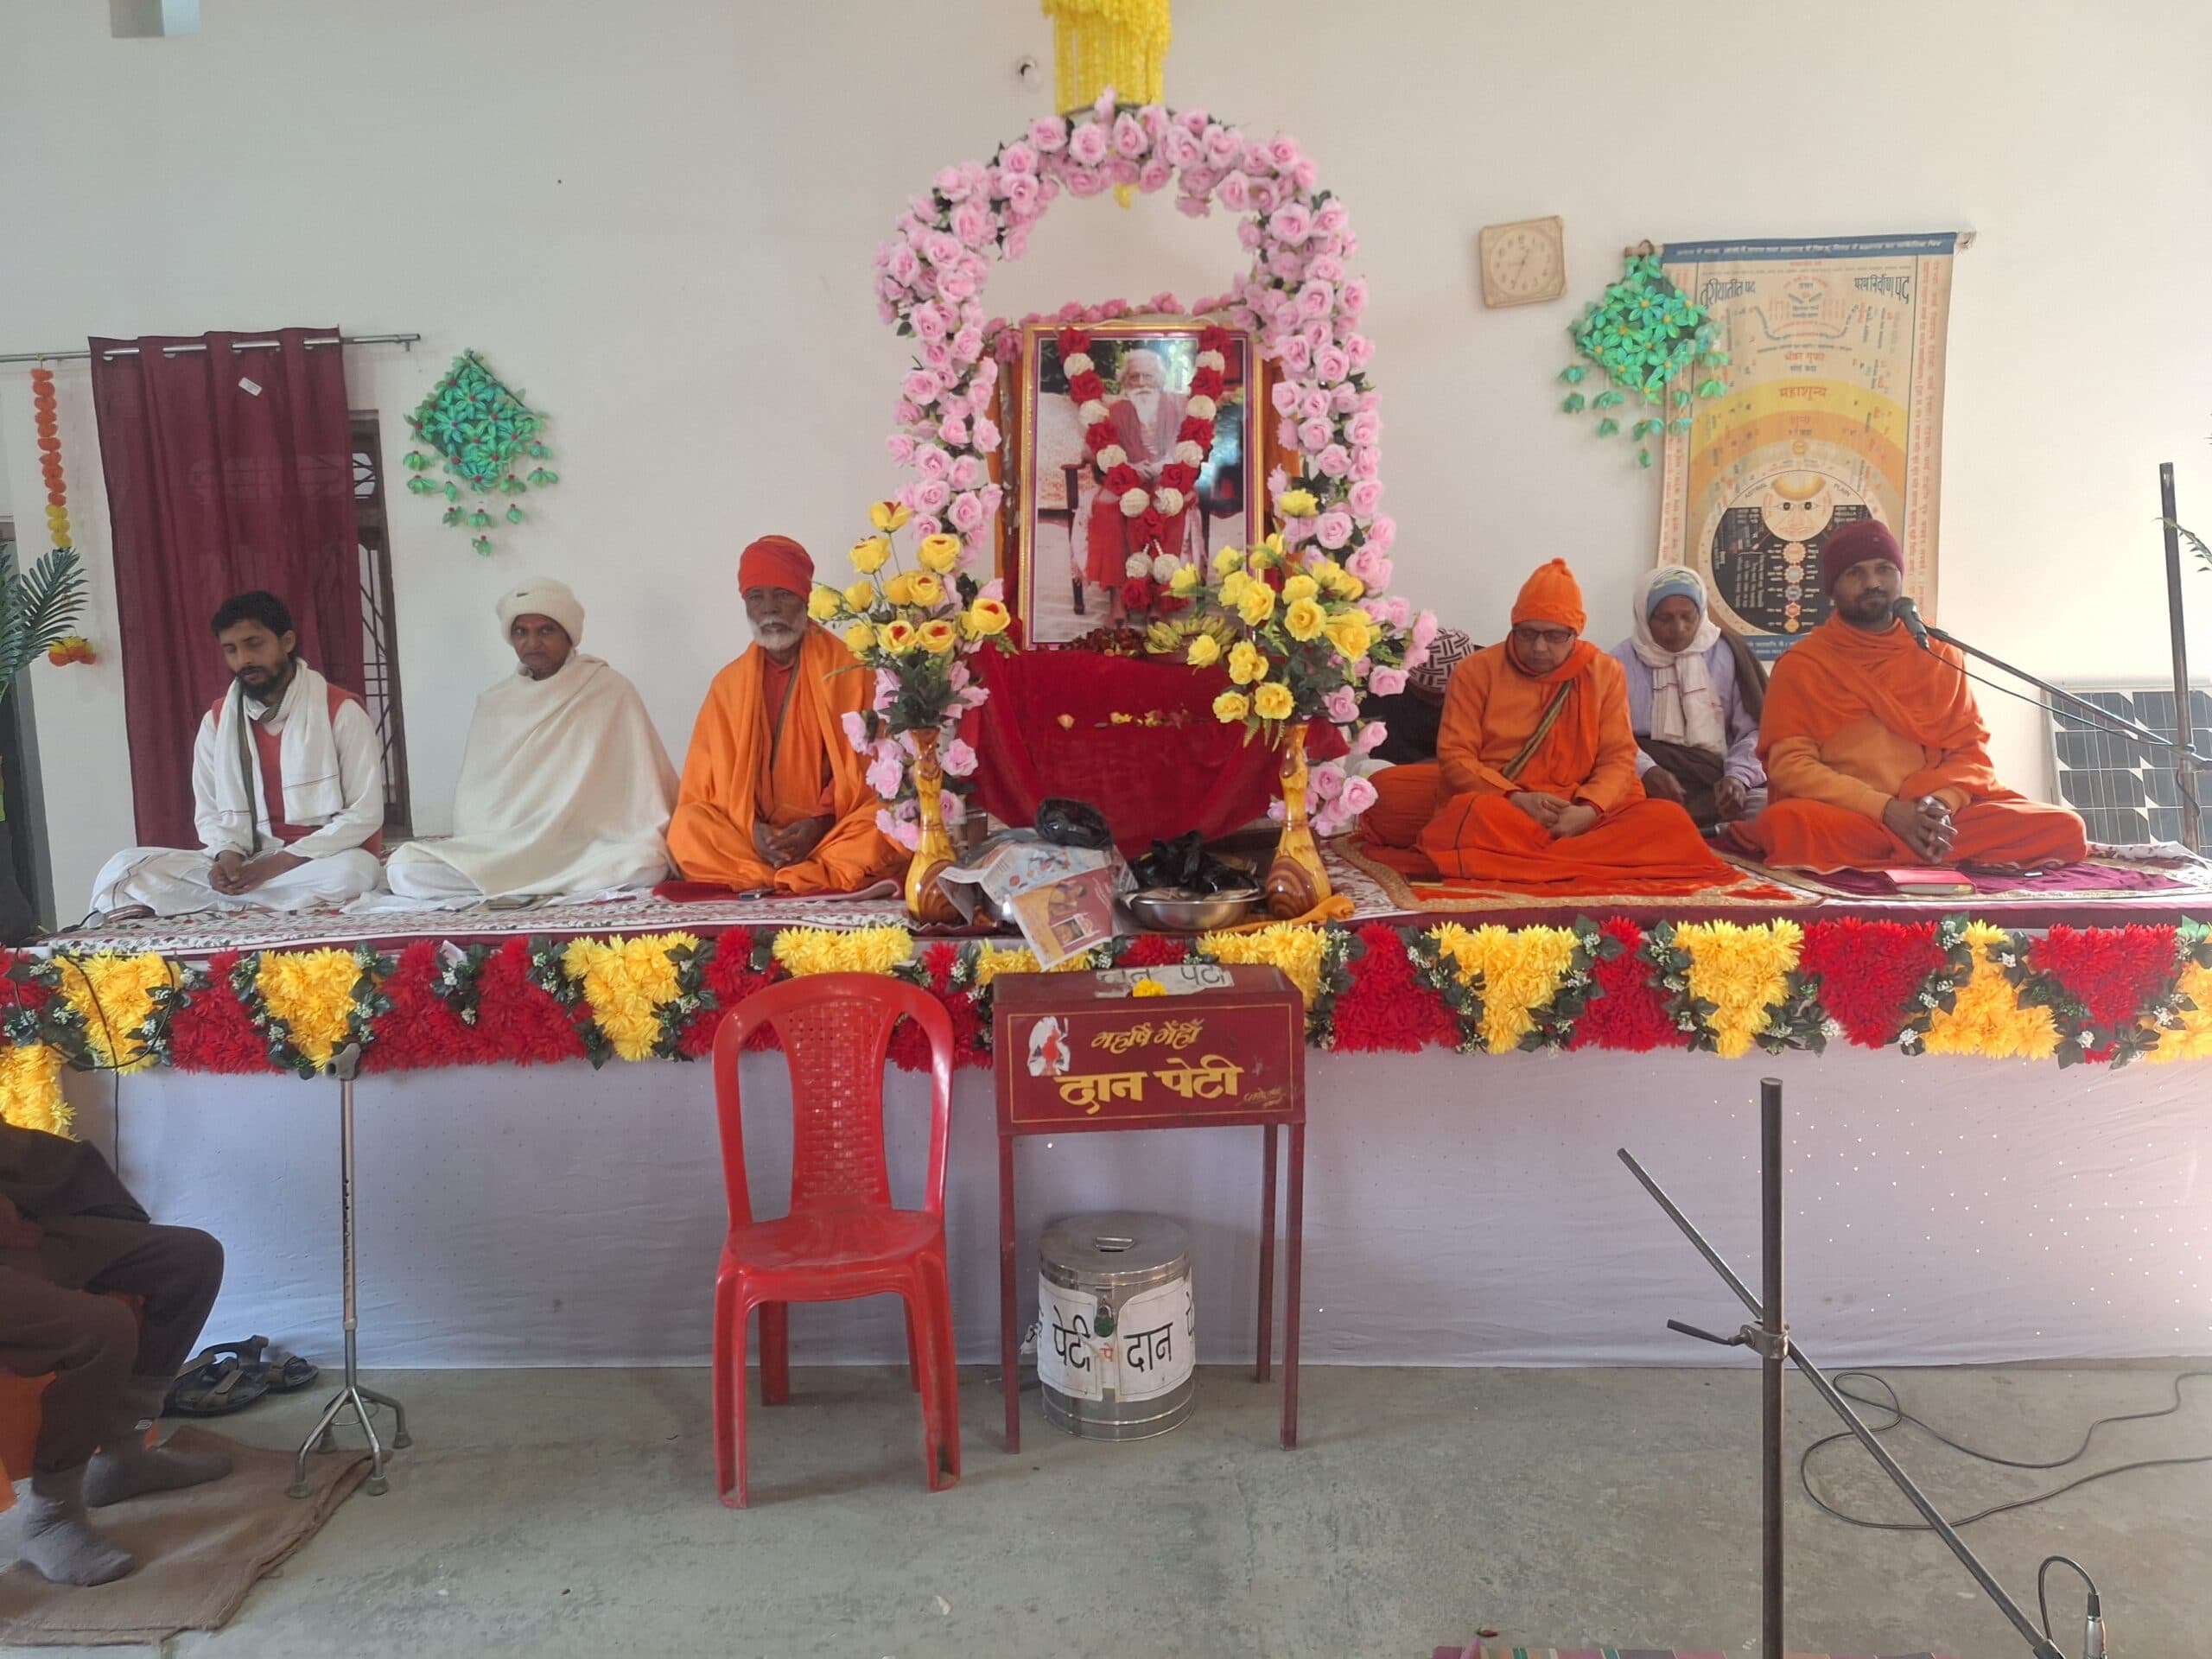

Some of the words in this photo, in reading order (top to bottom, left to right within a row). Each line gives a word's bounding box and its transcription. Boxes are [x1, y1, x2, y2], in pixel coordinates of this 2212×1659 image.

[1895, 276, 1910, 304] पद
[1053, 1071, 1147, 1115] दान
[1153, 1054, 1244, 1098] पेटी
[1052, 1305, 1091, 1372] पेटी
[1124, 1322, 1173, 1373] दान
